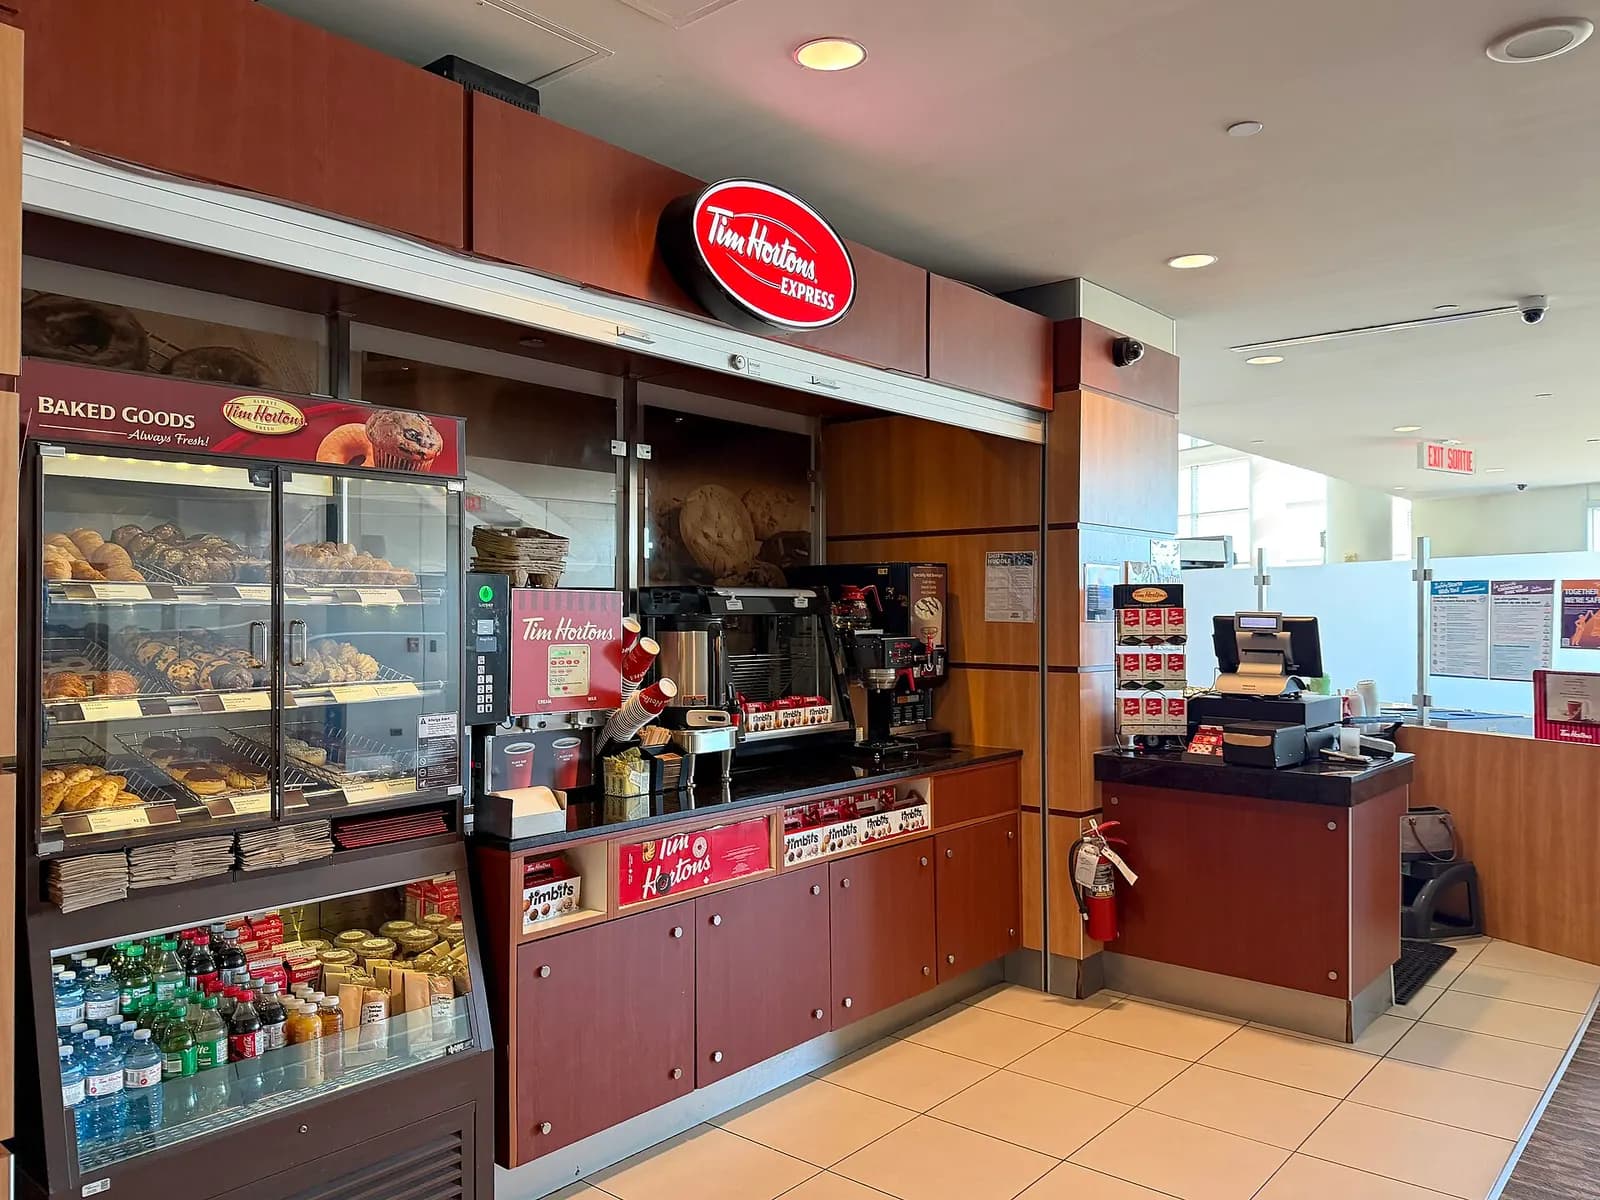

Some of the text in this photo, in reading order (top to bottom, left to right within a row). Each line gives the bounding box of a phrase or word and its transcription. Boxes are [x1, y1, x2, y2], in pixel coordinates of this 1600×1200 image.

[706, 205, 745, 255] Tim
[780, 276, 835, 310] EXPRESS
[38, 395, 196, 429] BAKED GOODS
[224, 402, 252, 420] Tim
[127, 429, 210, 447] Always Fresh!
[1428, 445, 1473, 472] EXIT SORTIE
[522, 617, 552, 641] Tim
[787, 834, 819, 850] timbits
[828, 823, 858, 840] timbits
[528, 882, 575, 906] timbits
